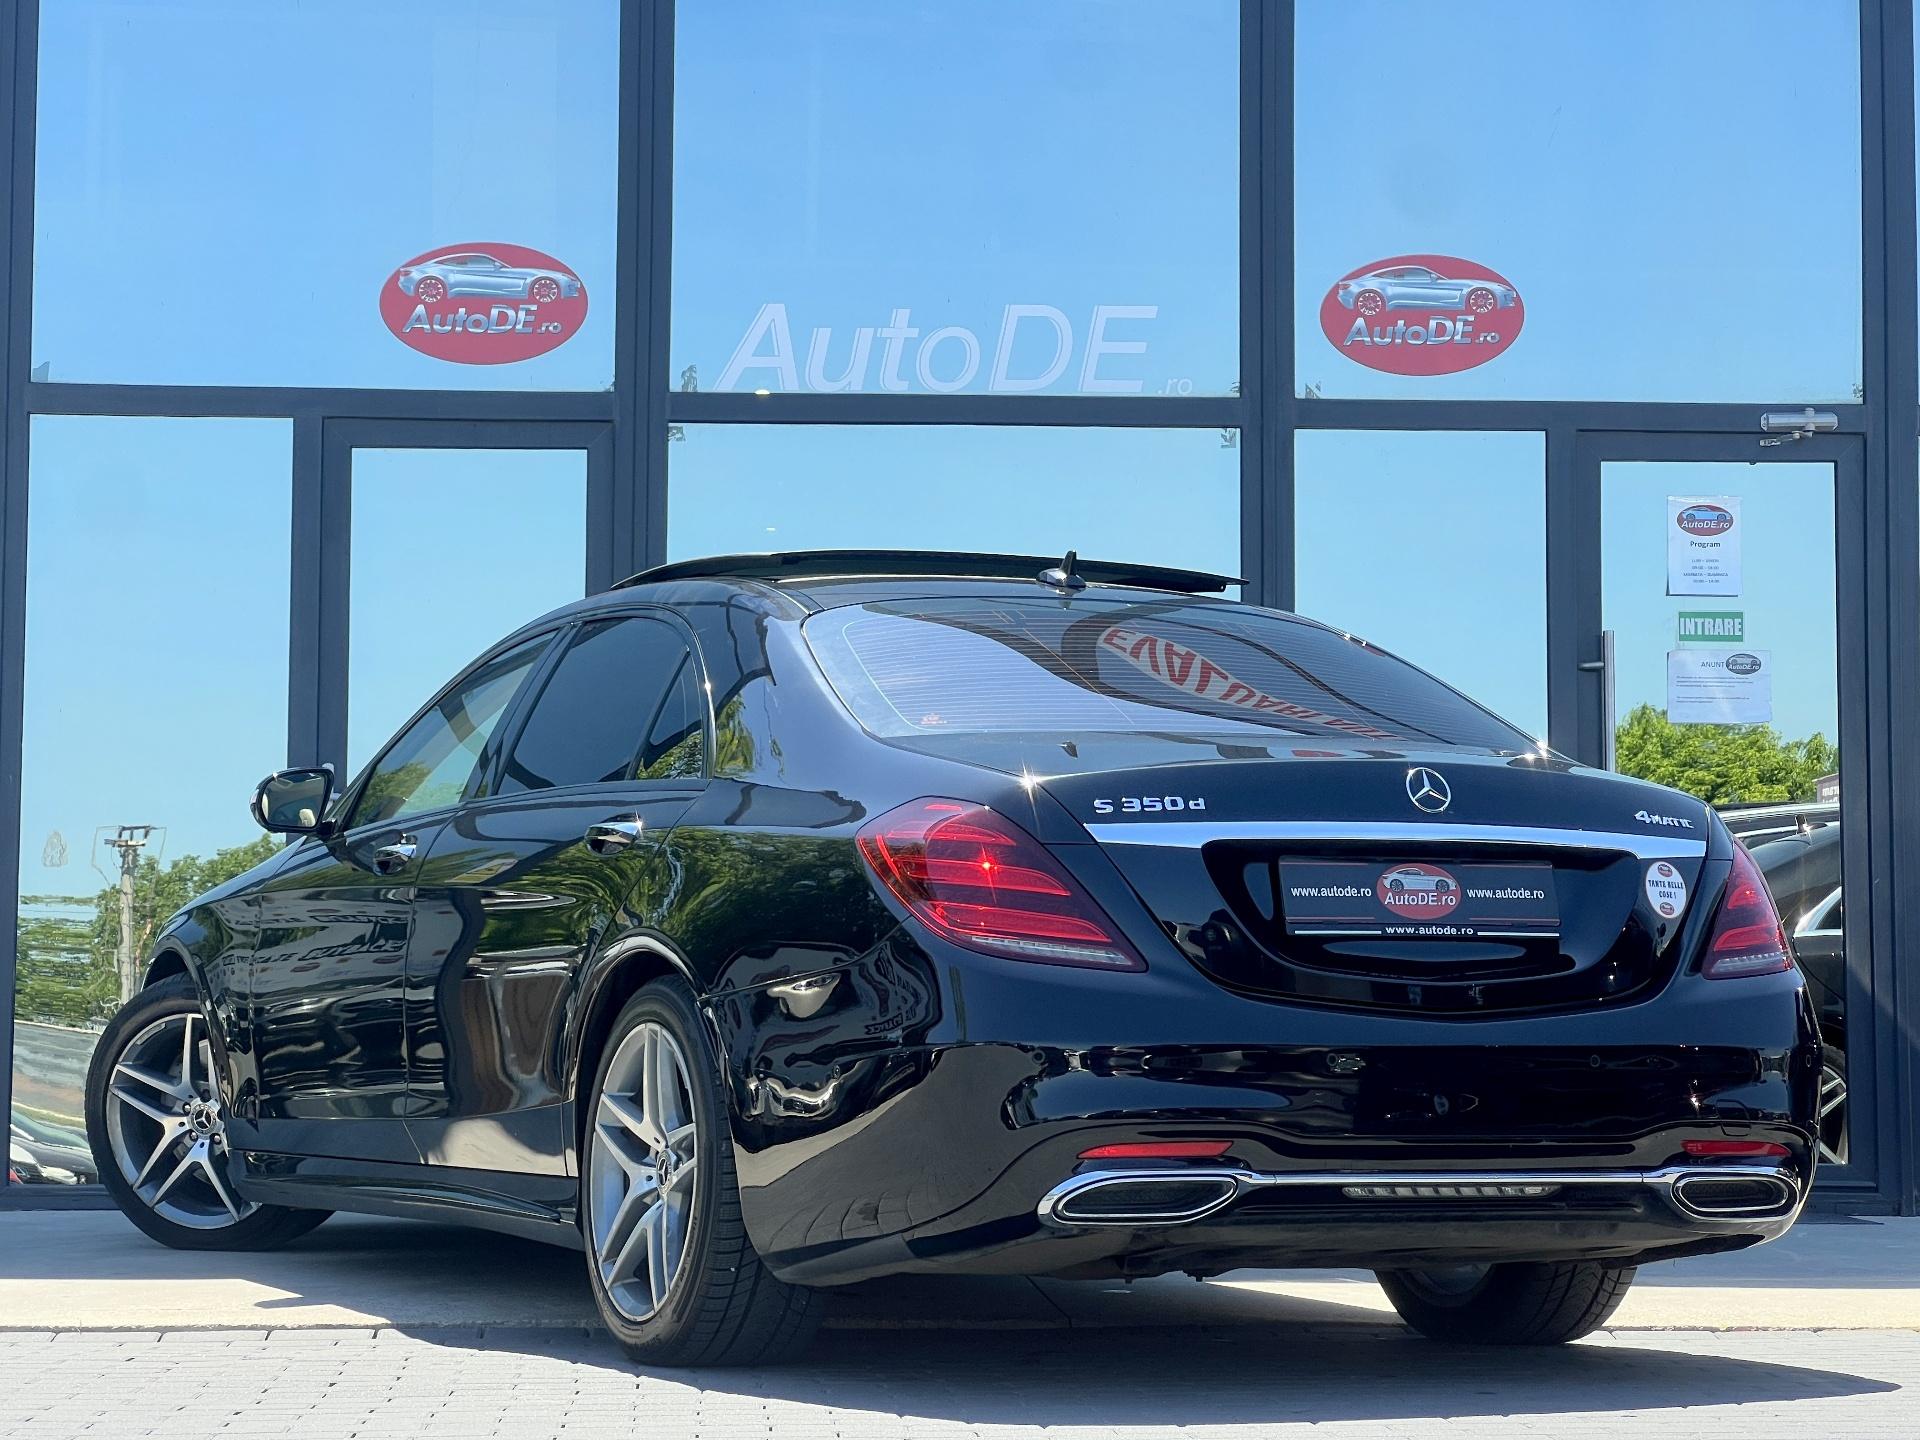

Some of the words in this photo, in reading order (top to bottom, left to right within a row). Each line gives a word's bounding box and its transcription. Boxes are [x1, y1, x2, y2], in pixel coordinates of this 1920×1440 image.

[1681, 520, 1730, 529] AutoDE.ro
[1690, 541, 1721, 549] Program
[1679, 617, 1742, 636] INTRARE
[1093, 799, 1114, 814] S
[1121, 796, 1185, 812] 350
[1188, 797, 1206, 810] d
[1634, 810, 1695, 829] 4MATIC
[1290, 886, 1372, 898] www.autode.ro
[1466, 887, 1545, 900] www.autode.ro
[1384, 892, 1457, 906] AutoDE.ro
[1385, 925, 1474, 936] www.autode.ro
